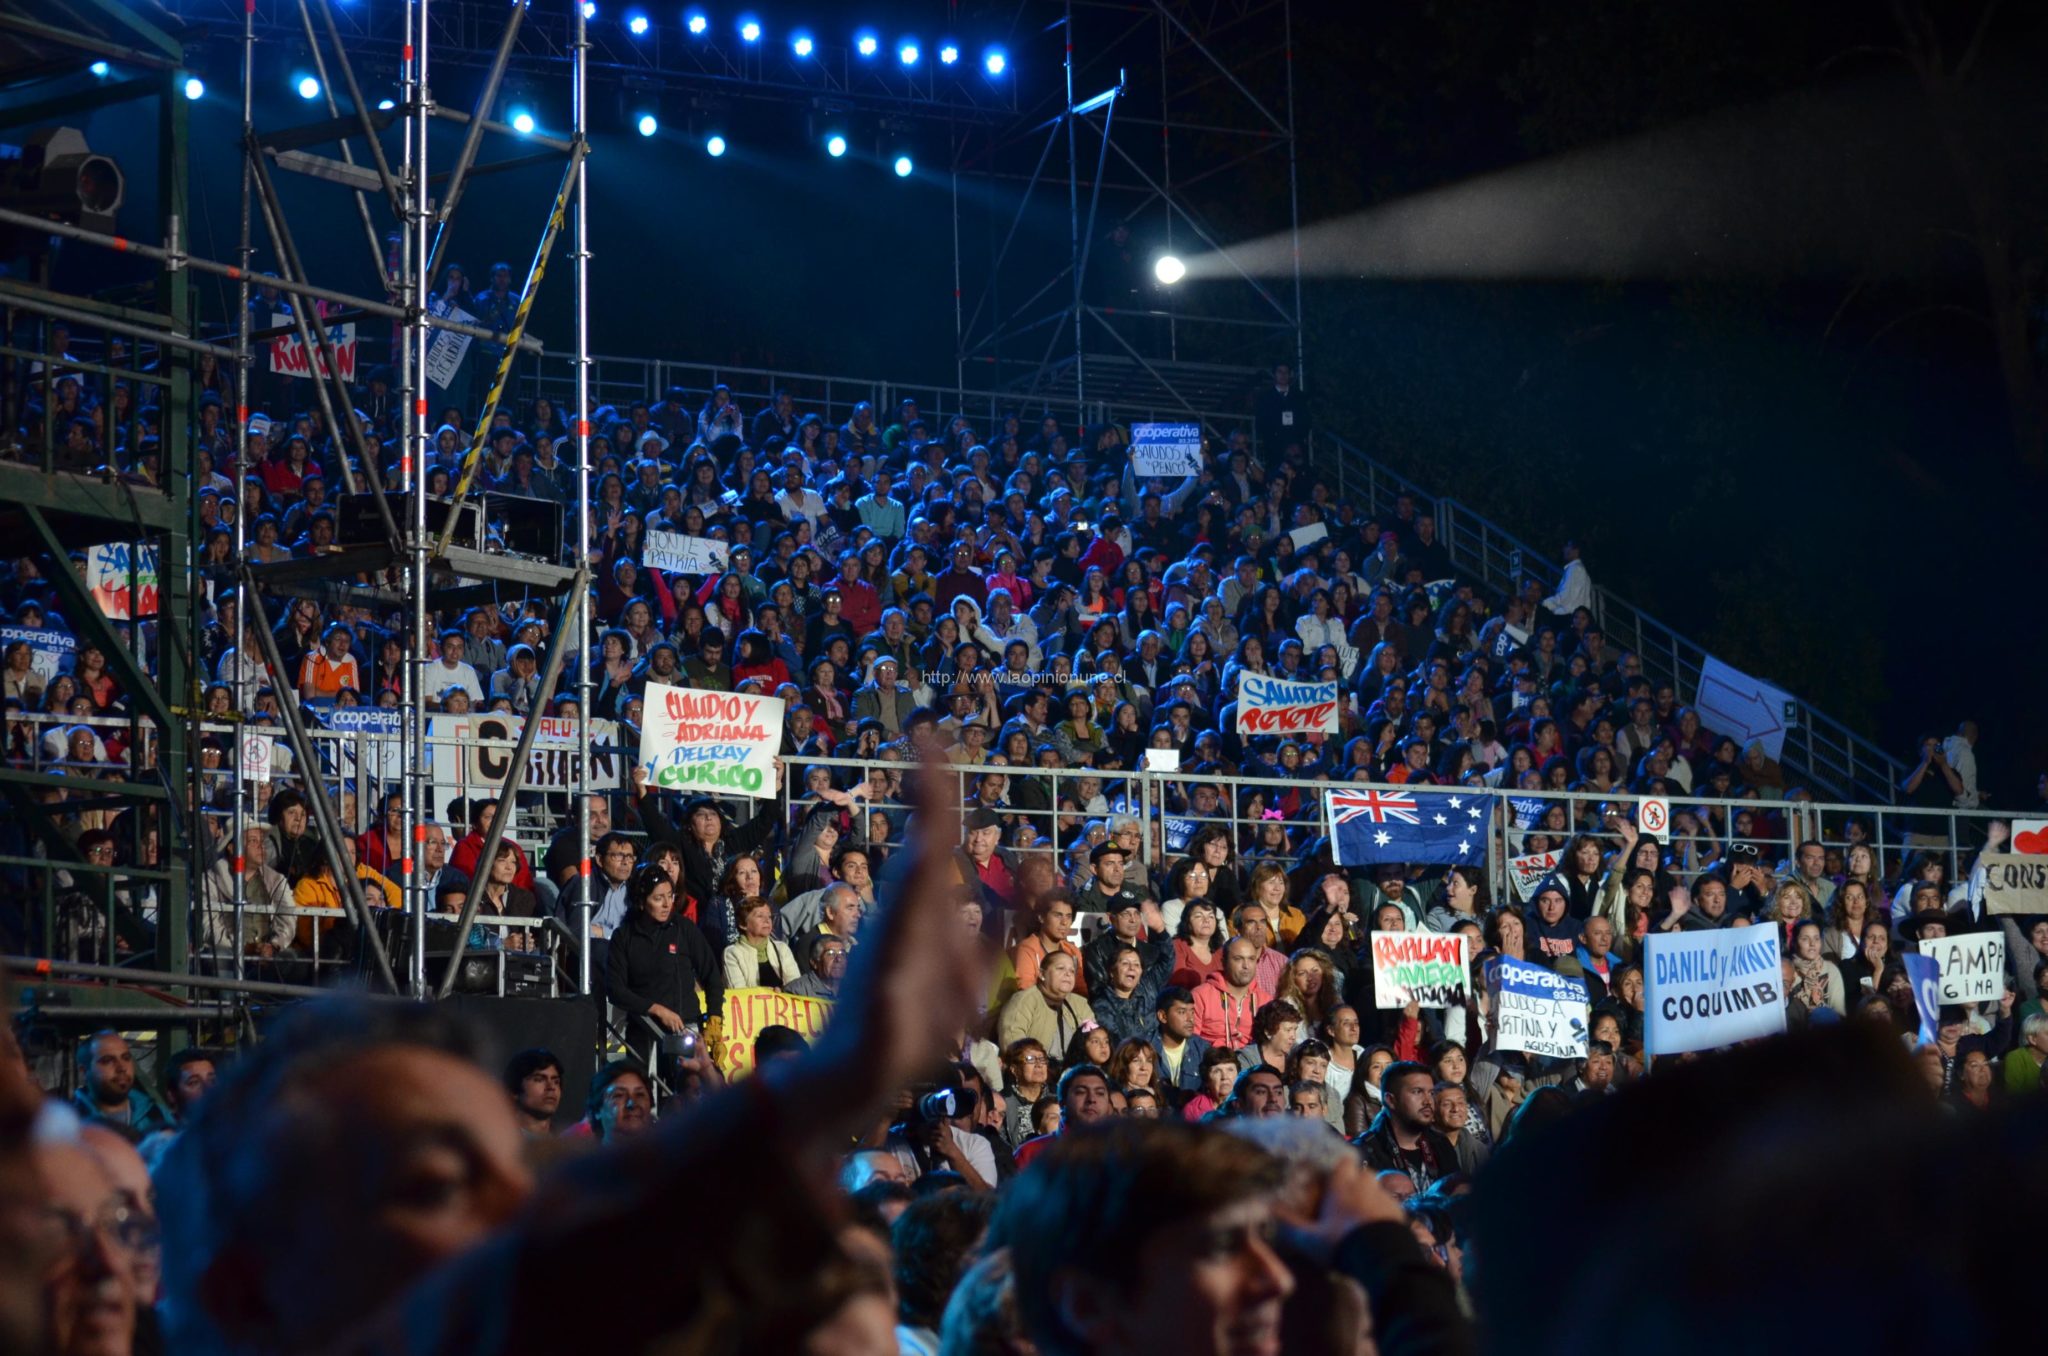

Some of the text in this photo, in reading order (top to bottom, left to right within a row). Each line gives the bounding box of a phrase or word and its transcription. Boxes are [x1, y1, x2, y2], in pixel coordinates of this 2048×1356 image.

[1133, 425, 1199, 440] cooperativa
[648, 531, 699, 556] MONTE
[648, 548, 698, 571] PATRIA
[1243, 678, 1336, 706] SALUDOS
[1986, 863, 2048, 892] CONS
[1656, 949, 1718, 985] DANILO
[1552, 990, 1576, 1000] 93.3
[1662, 982, 1778, 1021] COQUIMB
